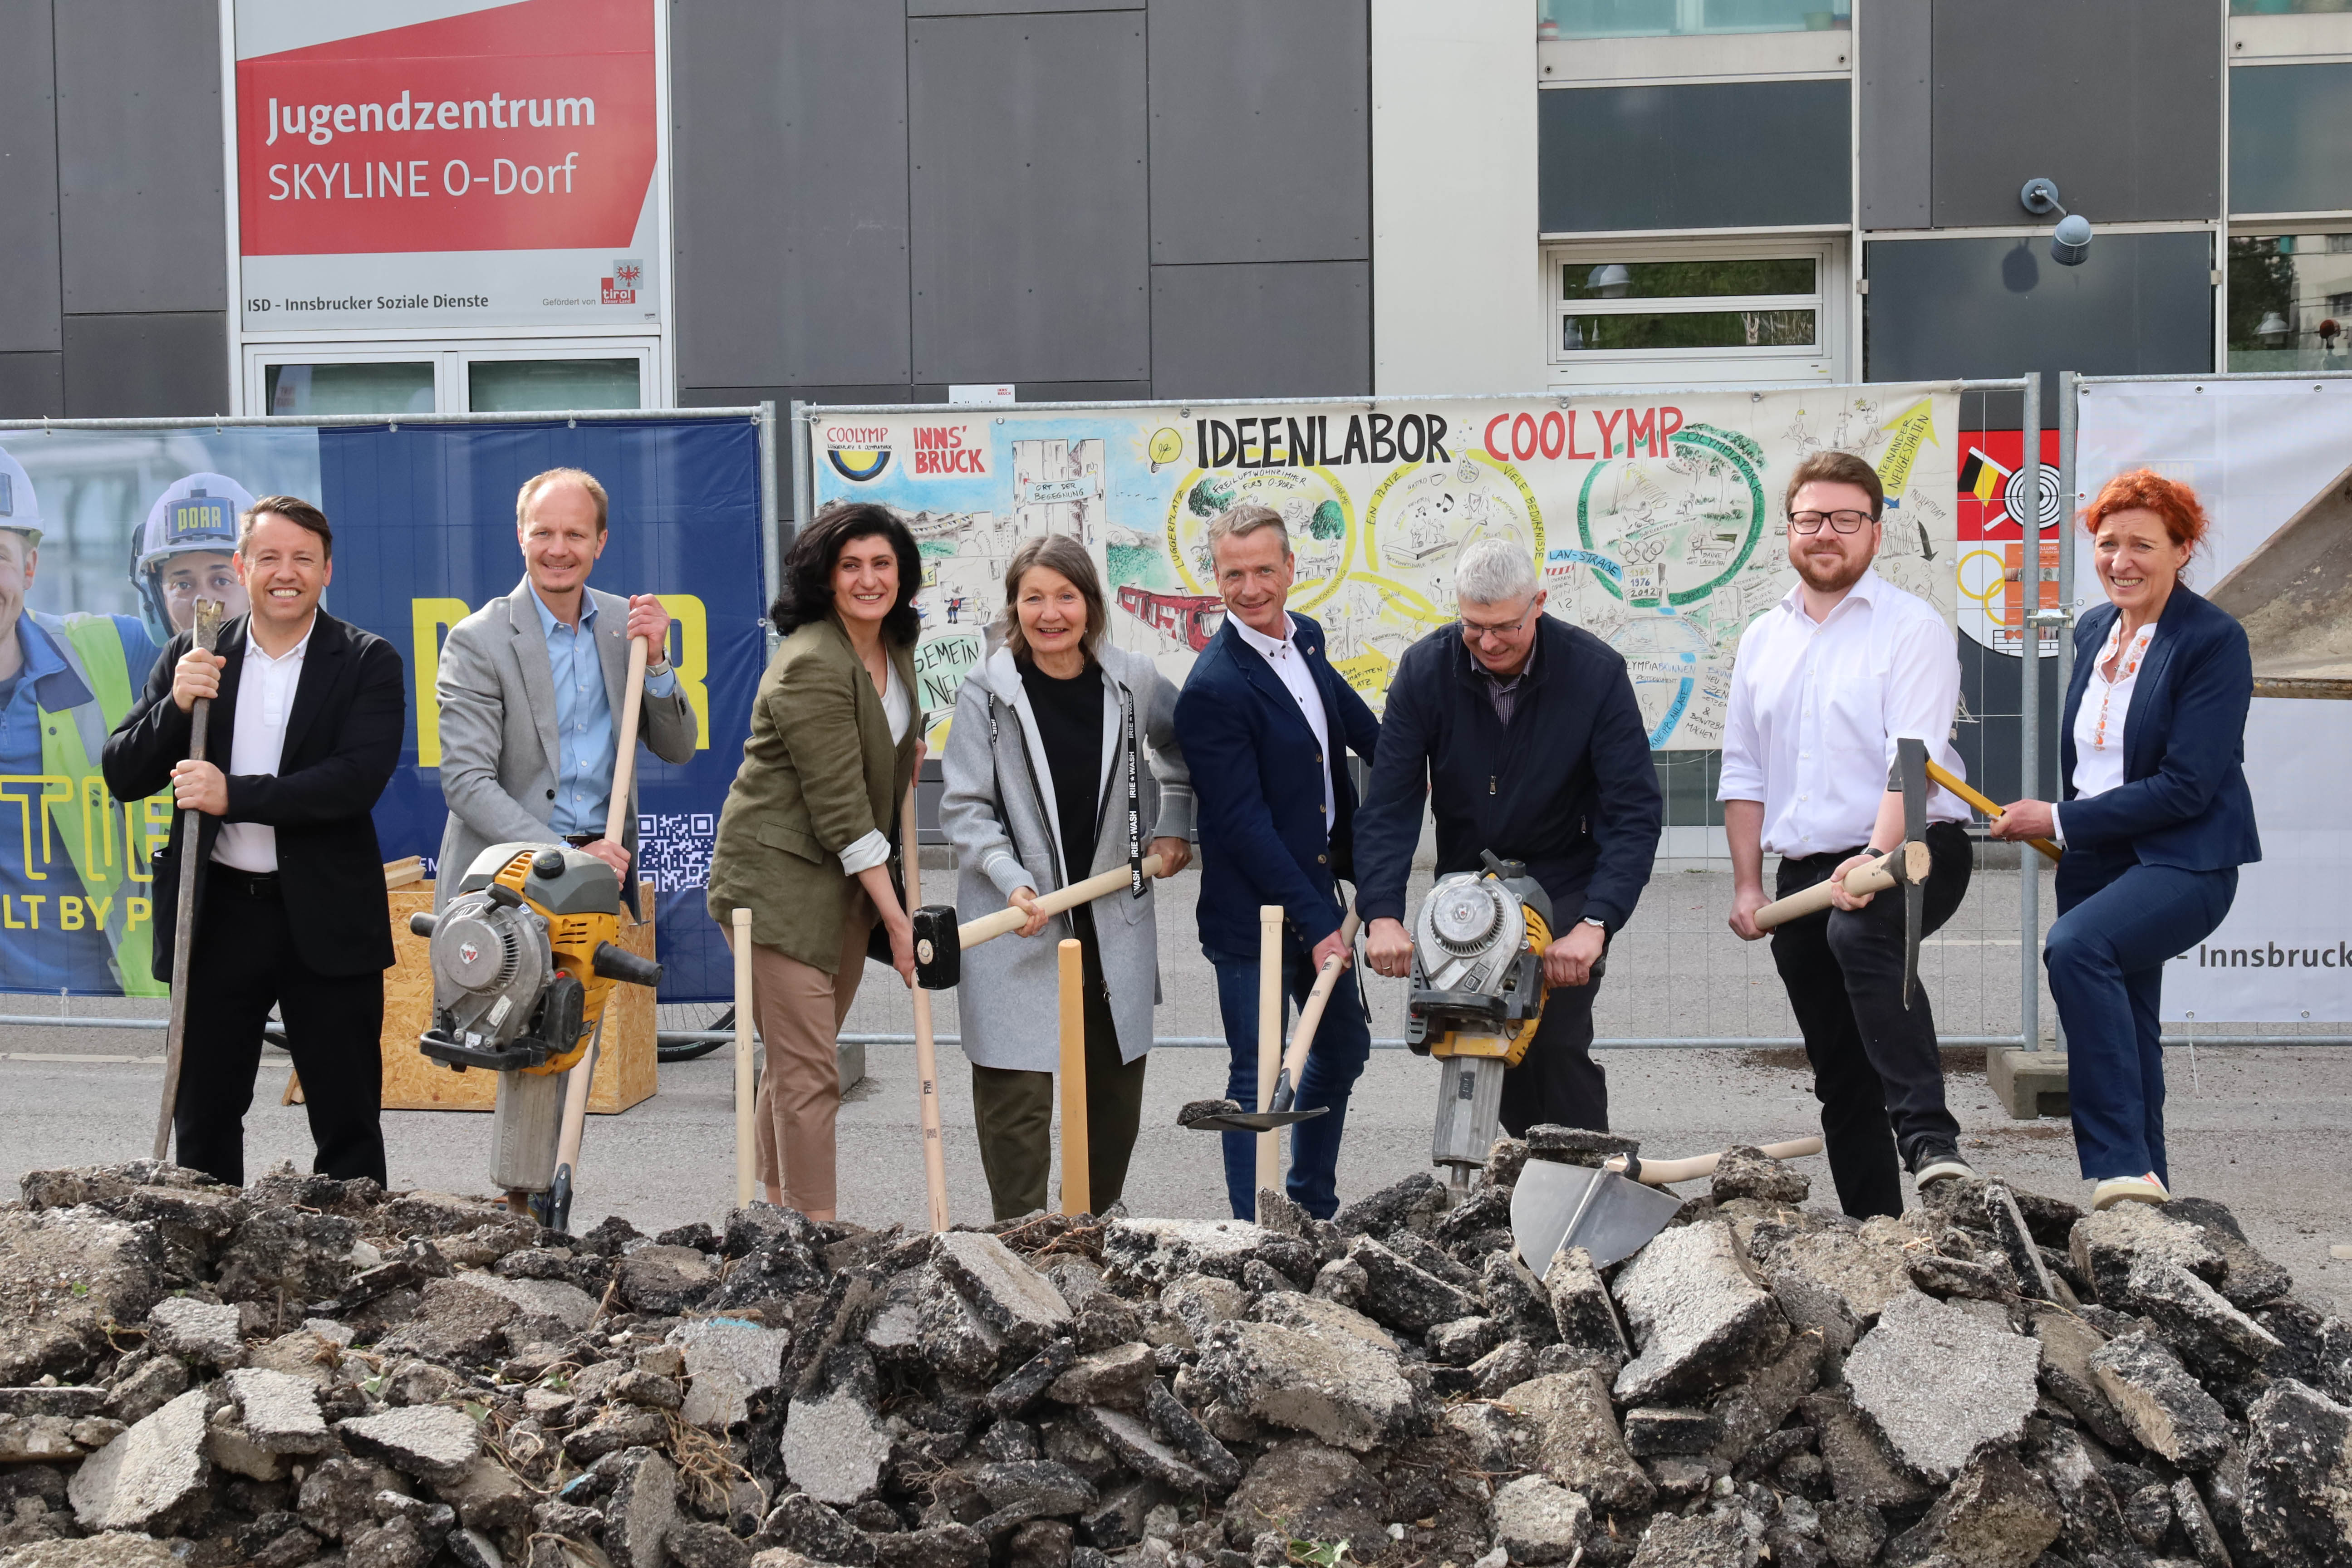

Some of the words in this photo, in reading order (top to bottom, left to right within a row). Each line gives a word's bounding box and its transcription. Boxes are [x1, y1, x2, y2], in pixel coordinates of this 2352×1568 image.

[265, 90, 595, 146] Jugendzentrum
[269, 161, 429, 201] SKYLINE
[443, 152, 579, 196] O-Dorf
[248, 299, 271, 312] ISD
[285, 295, 373, 311] Innsbrucker
[377, 294, 428, 309] Soziale
[434, 294, 489, 308] Dienste
[603, 289, 631, 299] tirol
[827, 427, 889, 443] COOLYMP
[913, 426, 967, 450] INNS'
[1197, 414, 1451, 469] IDEENLABOR
[1483, 405, 1684, 462] COOLYMP
[915, 449, 986, 474] BRUCK
[1887, 414, 1929, 489] NEUGESTALTEN
[1686, 431, 1763, 497] OLYMPIAPARK
[1034, 488, 1084, 501] BEGEGNUNG
[1268, 478, 1296, 490] O-DORF
[1330, 478, 1350, 507] CHARME
[1407, 477, 1428, 490] GASTRO
[1366, 505, 1377, 526] EIN
[1374, 471, 1402, 498] PLATZ
[177, 506, 221, 532] PORR
[1167, 490, 1184, 568] LUGGERPLATZ
[1297, 568, 1347, 612] ADENBEGRÜNUNG
[1544, 578, 1597, 604] HLEUNIGEN
[1552, 582, 1571, 590] ODER
[1630, 578, 1650, 587] 1976
[1341, 667, 1356, 676] ZUM
[1625, 660, 1696, 674] LYMPIABRUNNEN
[1706, 666, 1733, 679] BRUNN
[412, 594, 710, 768] PR
[1706, 675, 1720, 685] NEU
[1649, 688, 1689, 748] KNEIPP-ANLAGE
[1689, 712, 1725, 730] BENUTZBA
[1685, 722, 1718, 741] MACHEN
[1129, 810, 1138, 835] WASH
[59, 896, 113, 931] BY
[923, 1080, 932, 1095] FM
